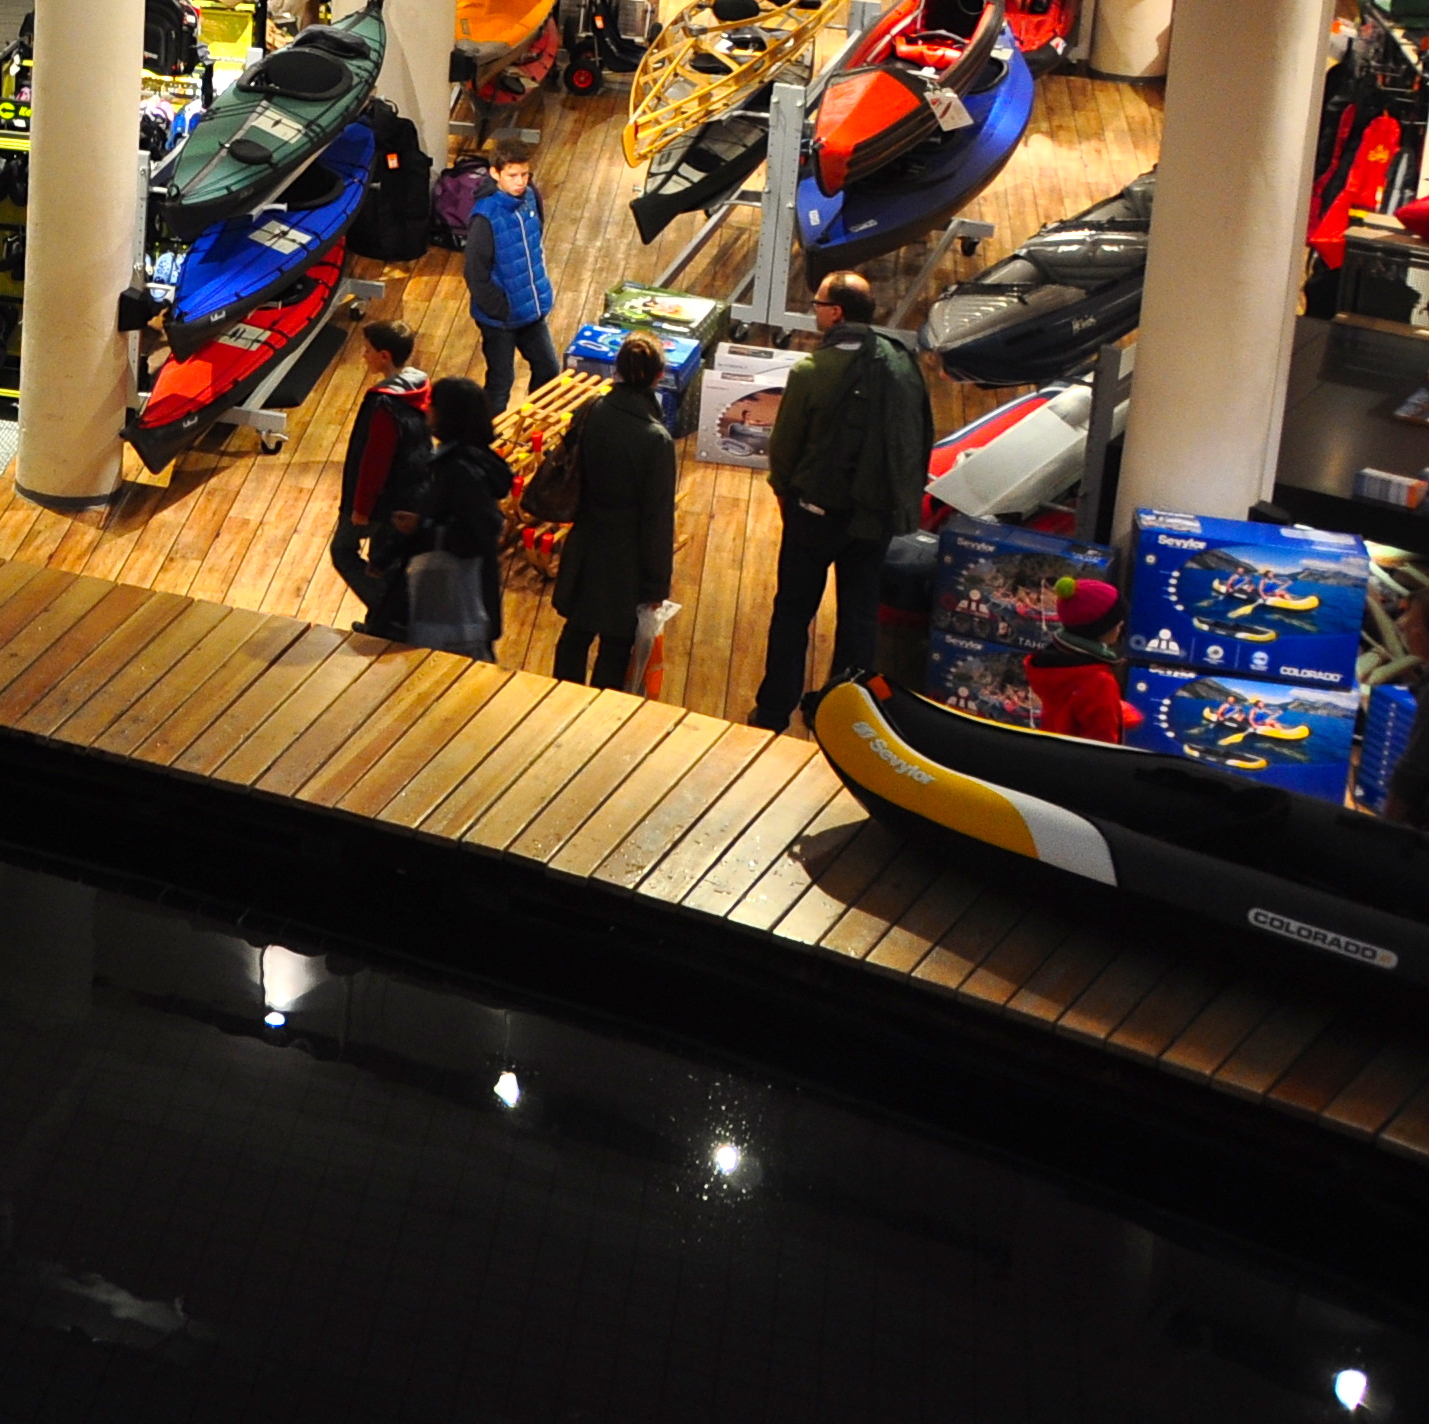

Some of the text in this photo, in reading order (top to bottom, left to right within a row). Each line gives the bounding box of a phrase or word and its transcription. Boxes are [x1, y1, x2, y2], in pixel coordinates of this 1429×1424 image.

[956, 536, 997, 553] Sevylor
[1157, 534, 1207, 551] Sevylor
[945, 634, 983, 651] Sevylor
[1279, 665, 1342, 683] COLORADO
[869, 738, 937, 785] Sevylor
[1253, 911, 1377, 960] COLORADO
